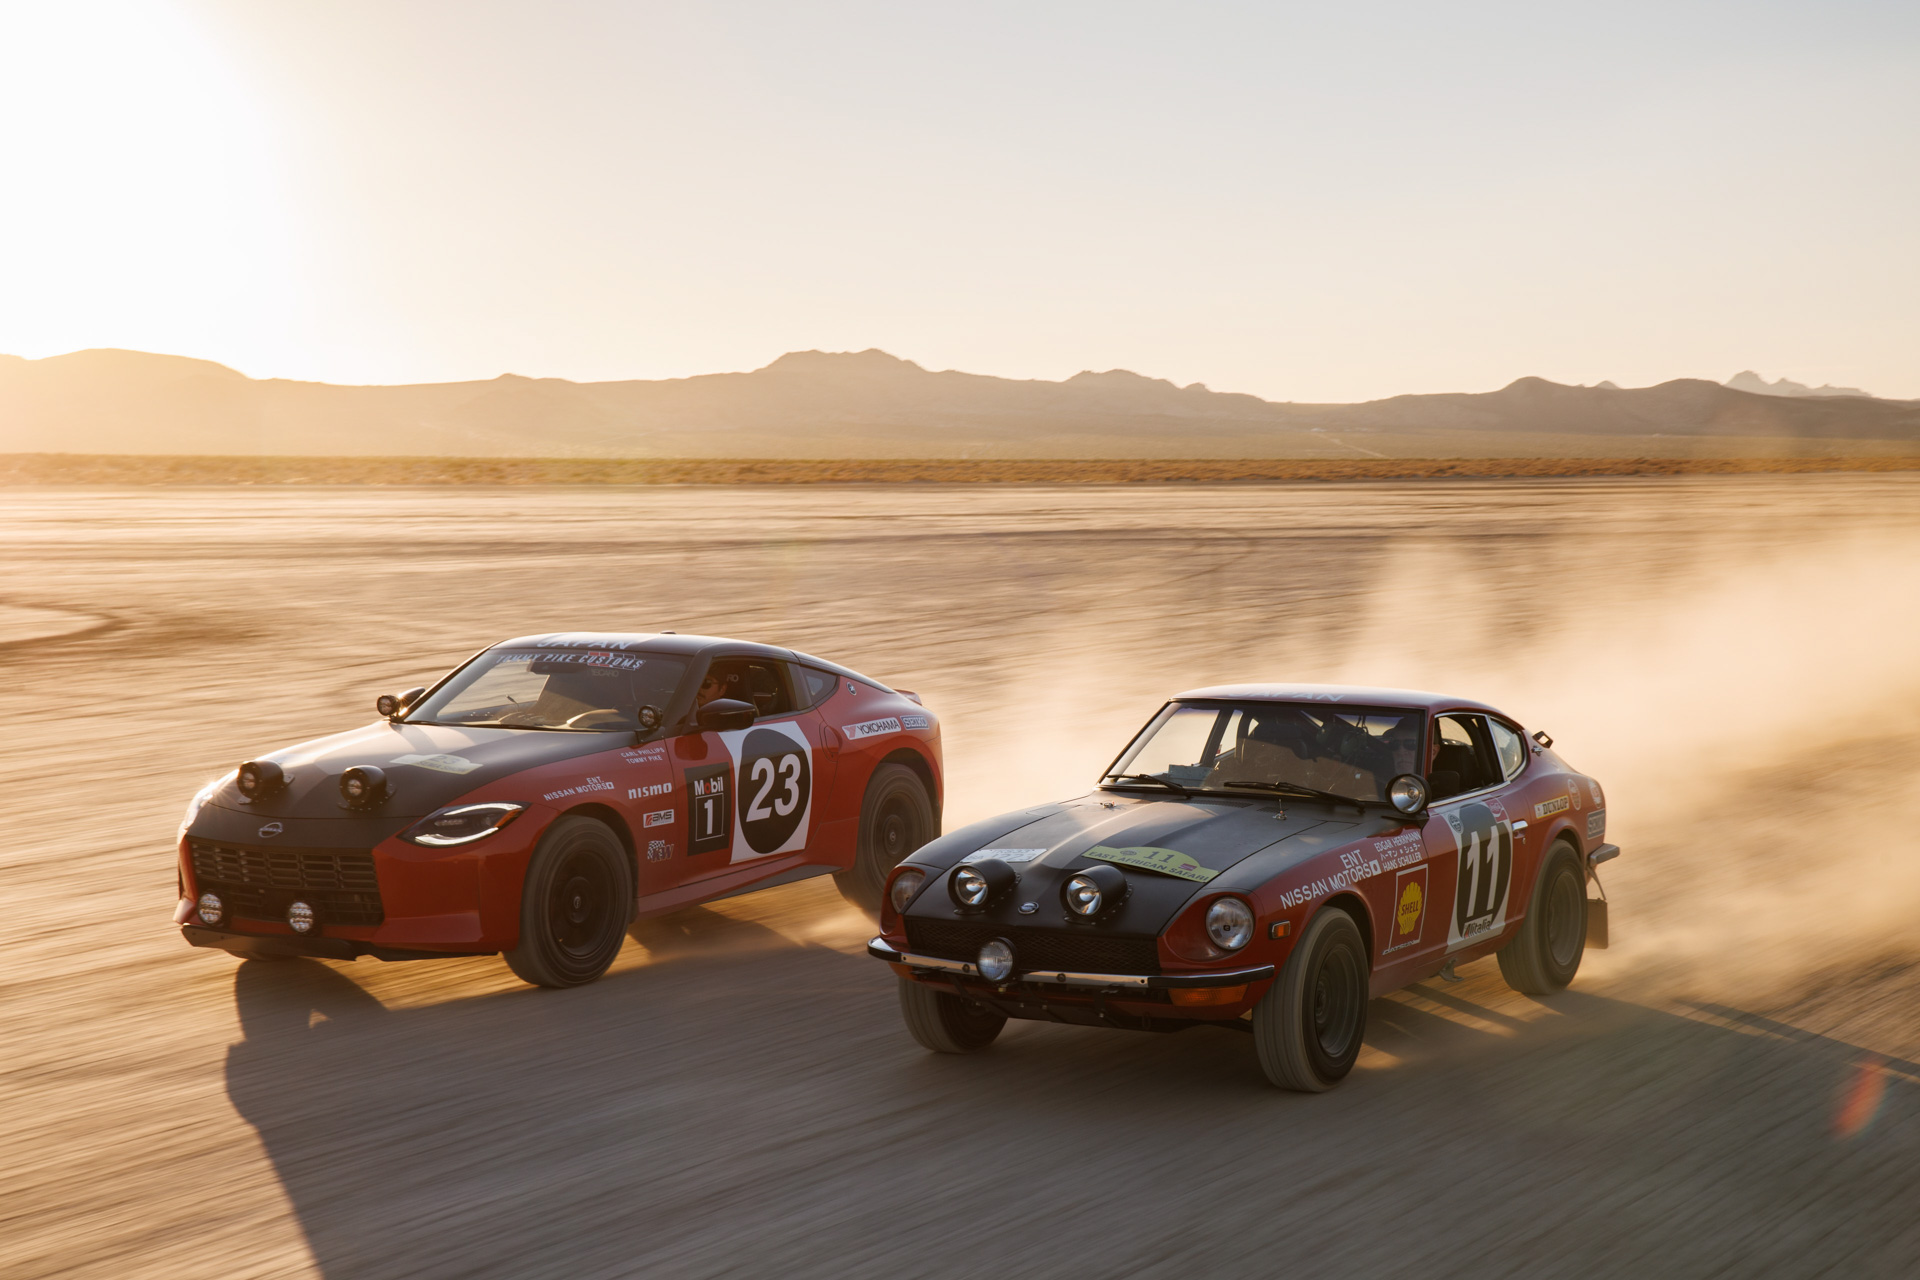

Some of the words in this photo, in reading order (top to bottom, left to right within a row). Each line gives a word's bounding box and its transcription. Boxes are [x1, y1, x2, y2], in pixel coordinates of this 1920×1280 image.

[537, 640, 635, 650] JAPAN
[496, 654, 542, 663] TOMMY
[543, 654, 576, 662] PIKE
[578, 655, 645, 668] CUSTOMS
[857, 720, 900, 735] YOKOHAMA
[621, 750, 638, 759] CARL
[639, 747, 665, 756] PHILLIPS
[626, 756, 648, 764] TOMMY
[586, 776, 604, 785] ENT.
[694, 777, 723, 795] Mobil
[746, 754, 801, 822] 23
[543, 788, 576, 801] NISSAN
[576, 782, 607, 794] MOTORS
[1542, 797, 1568, 815] DUNLOP
[704, 799, 713, 834] 1
[1374, 840, 1394, 852] EDGAR
[1143, 851, 1175, 863] 11
[1340, 850, 1367, 869] ENT.
[1382, 859, 1398, 872] HANS
[1089, 851, 1116, 860] EAST
[1118, 857, 1168, 871] AFRICAN
[1169, 868, 1209, 881] SAFARI
[1466, 825, 1500, 918] 11
[1280, 879, 1329, 910] NISSAN
[1328, 864, 1372, 891] MOTORS
[1401, 900, 1419, 916] SHELL
[1464, 918, 1492, 938] Alitalia
